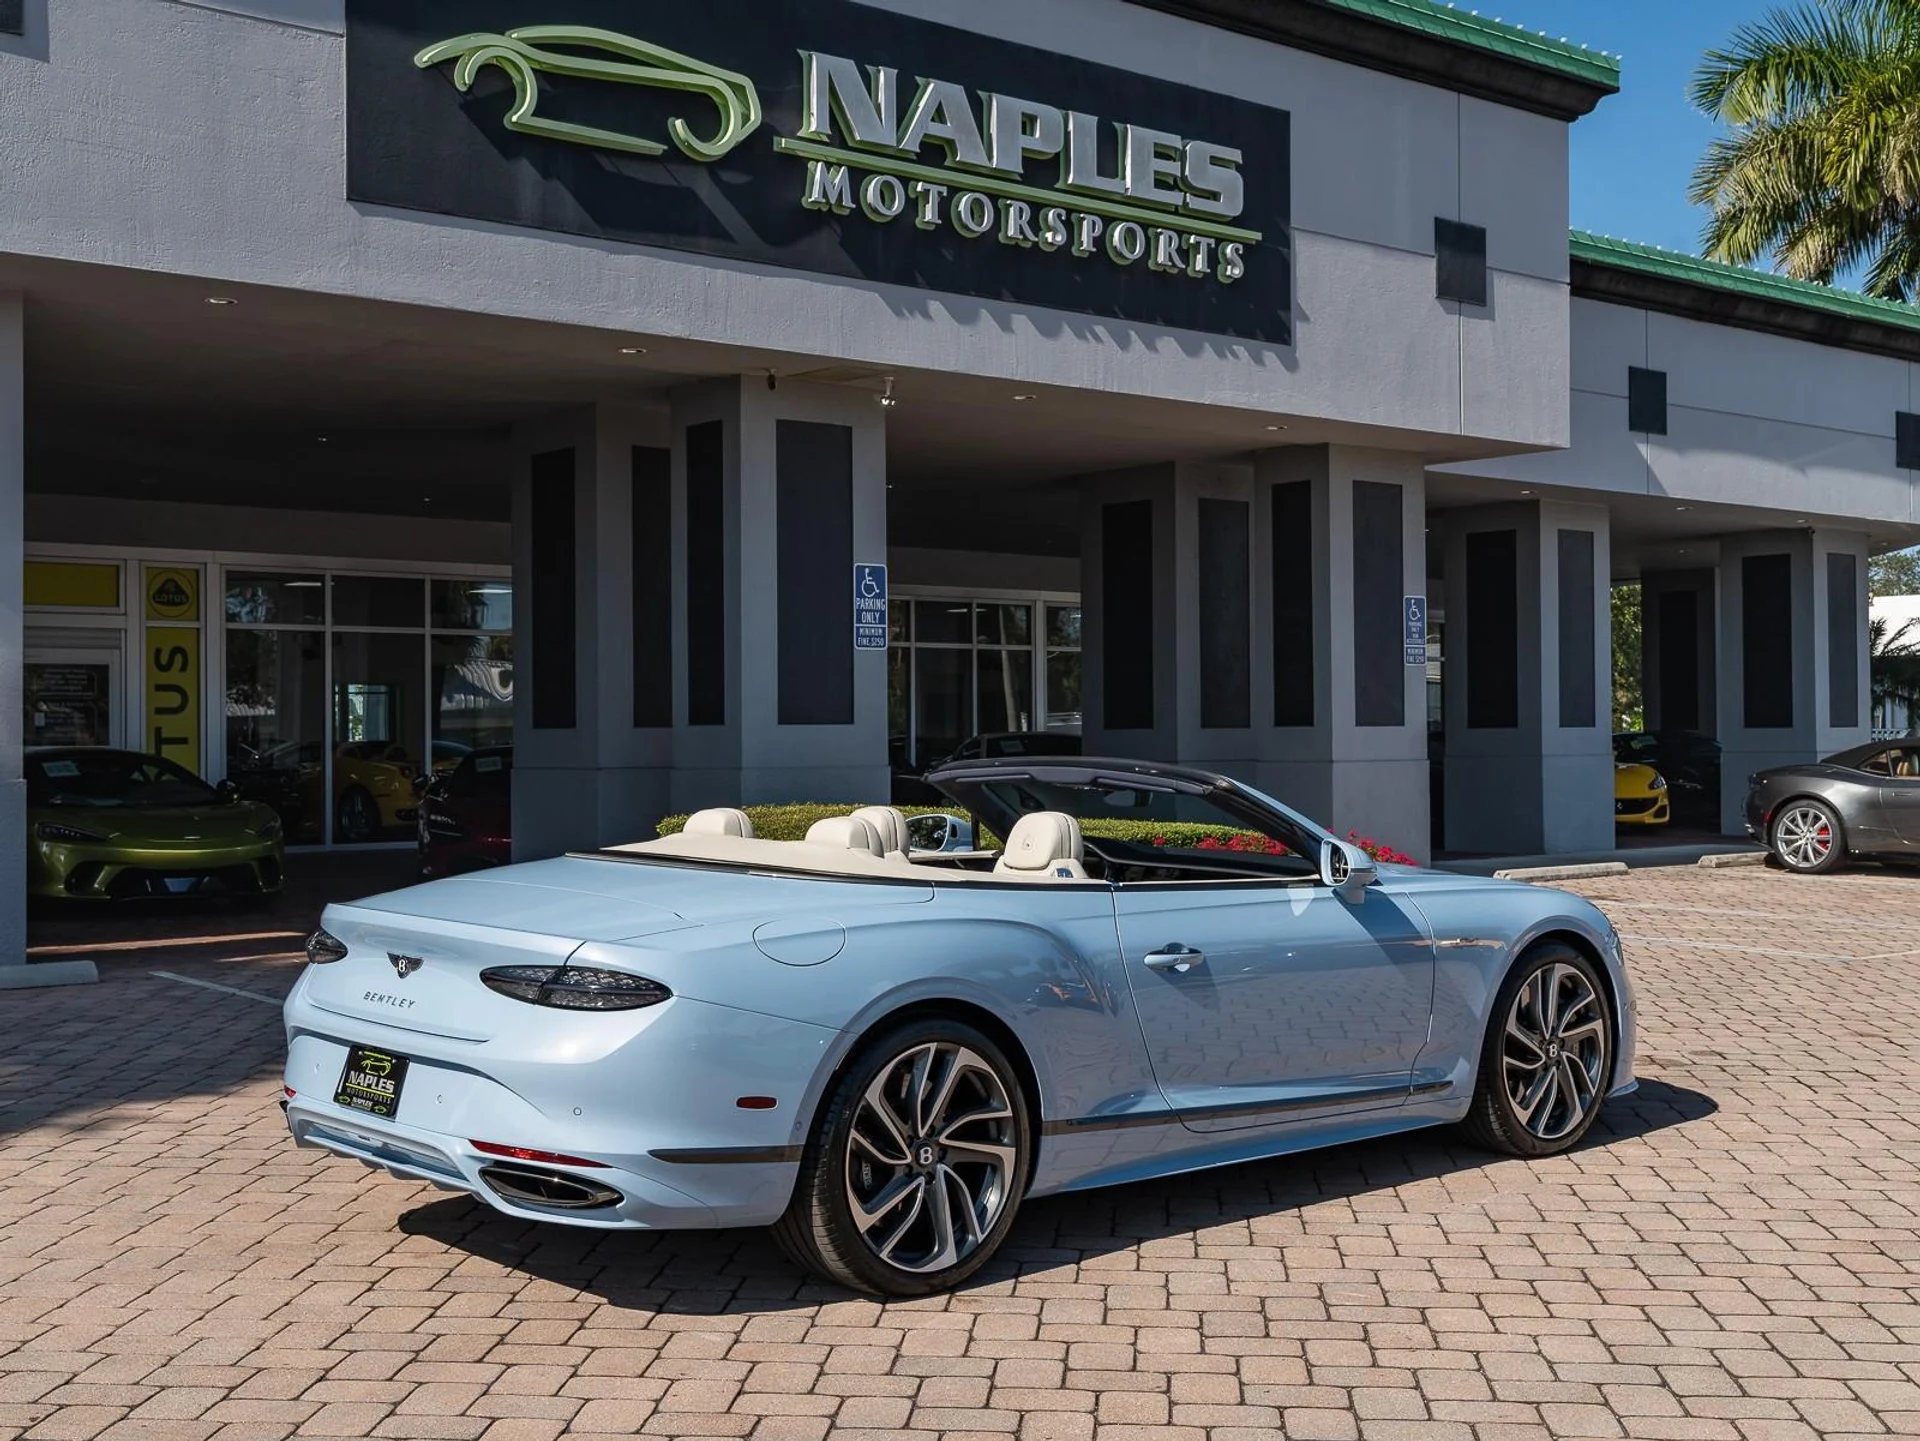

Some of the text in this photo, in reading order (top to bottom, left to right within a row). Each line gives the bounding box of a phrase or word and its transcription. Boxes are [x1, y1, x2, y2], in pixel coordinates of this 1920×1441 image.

[797, 48, 1245, 224] NAPLES
[801, 160, 1245, 284] MOTORSPORTS
[155, 593, 188, 602] LOTUS
[856, 598, 886, 611] PARKING
[861, 611, 880, 624] ONLY
[859, 627, 883, 636] MINIMUM
[857, 637, 885, 647] FINE $250
[154, 645, 189, 757] TUS
[398, 958, 407, 973] B
[363, 990, 416, 1009] BENTLEY
[348, 1070, 395, 1093] NAPLES
[919, 1146, 933, 1165] B
